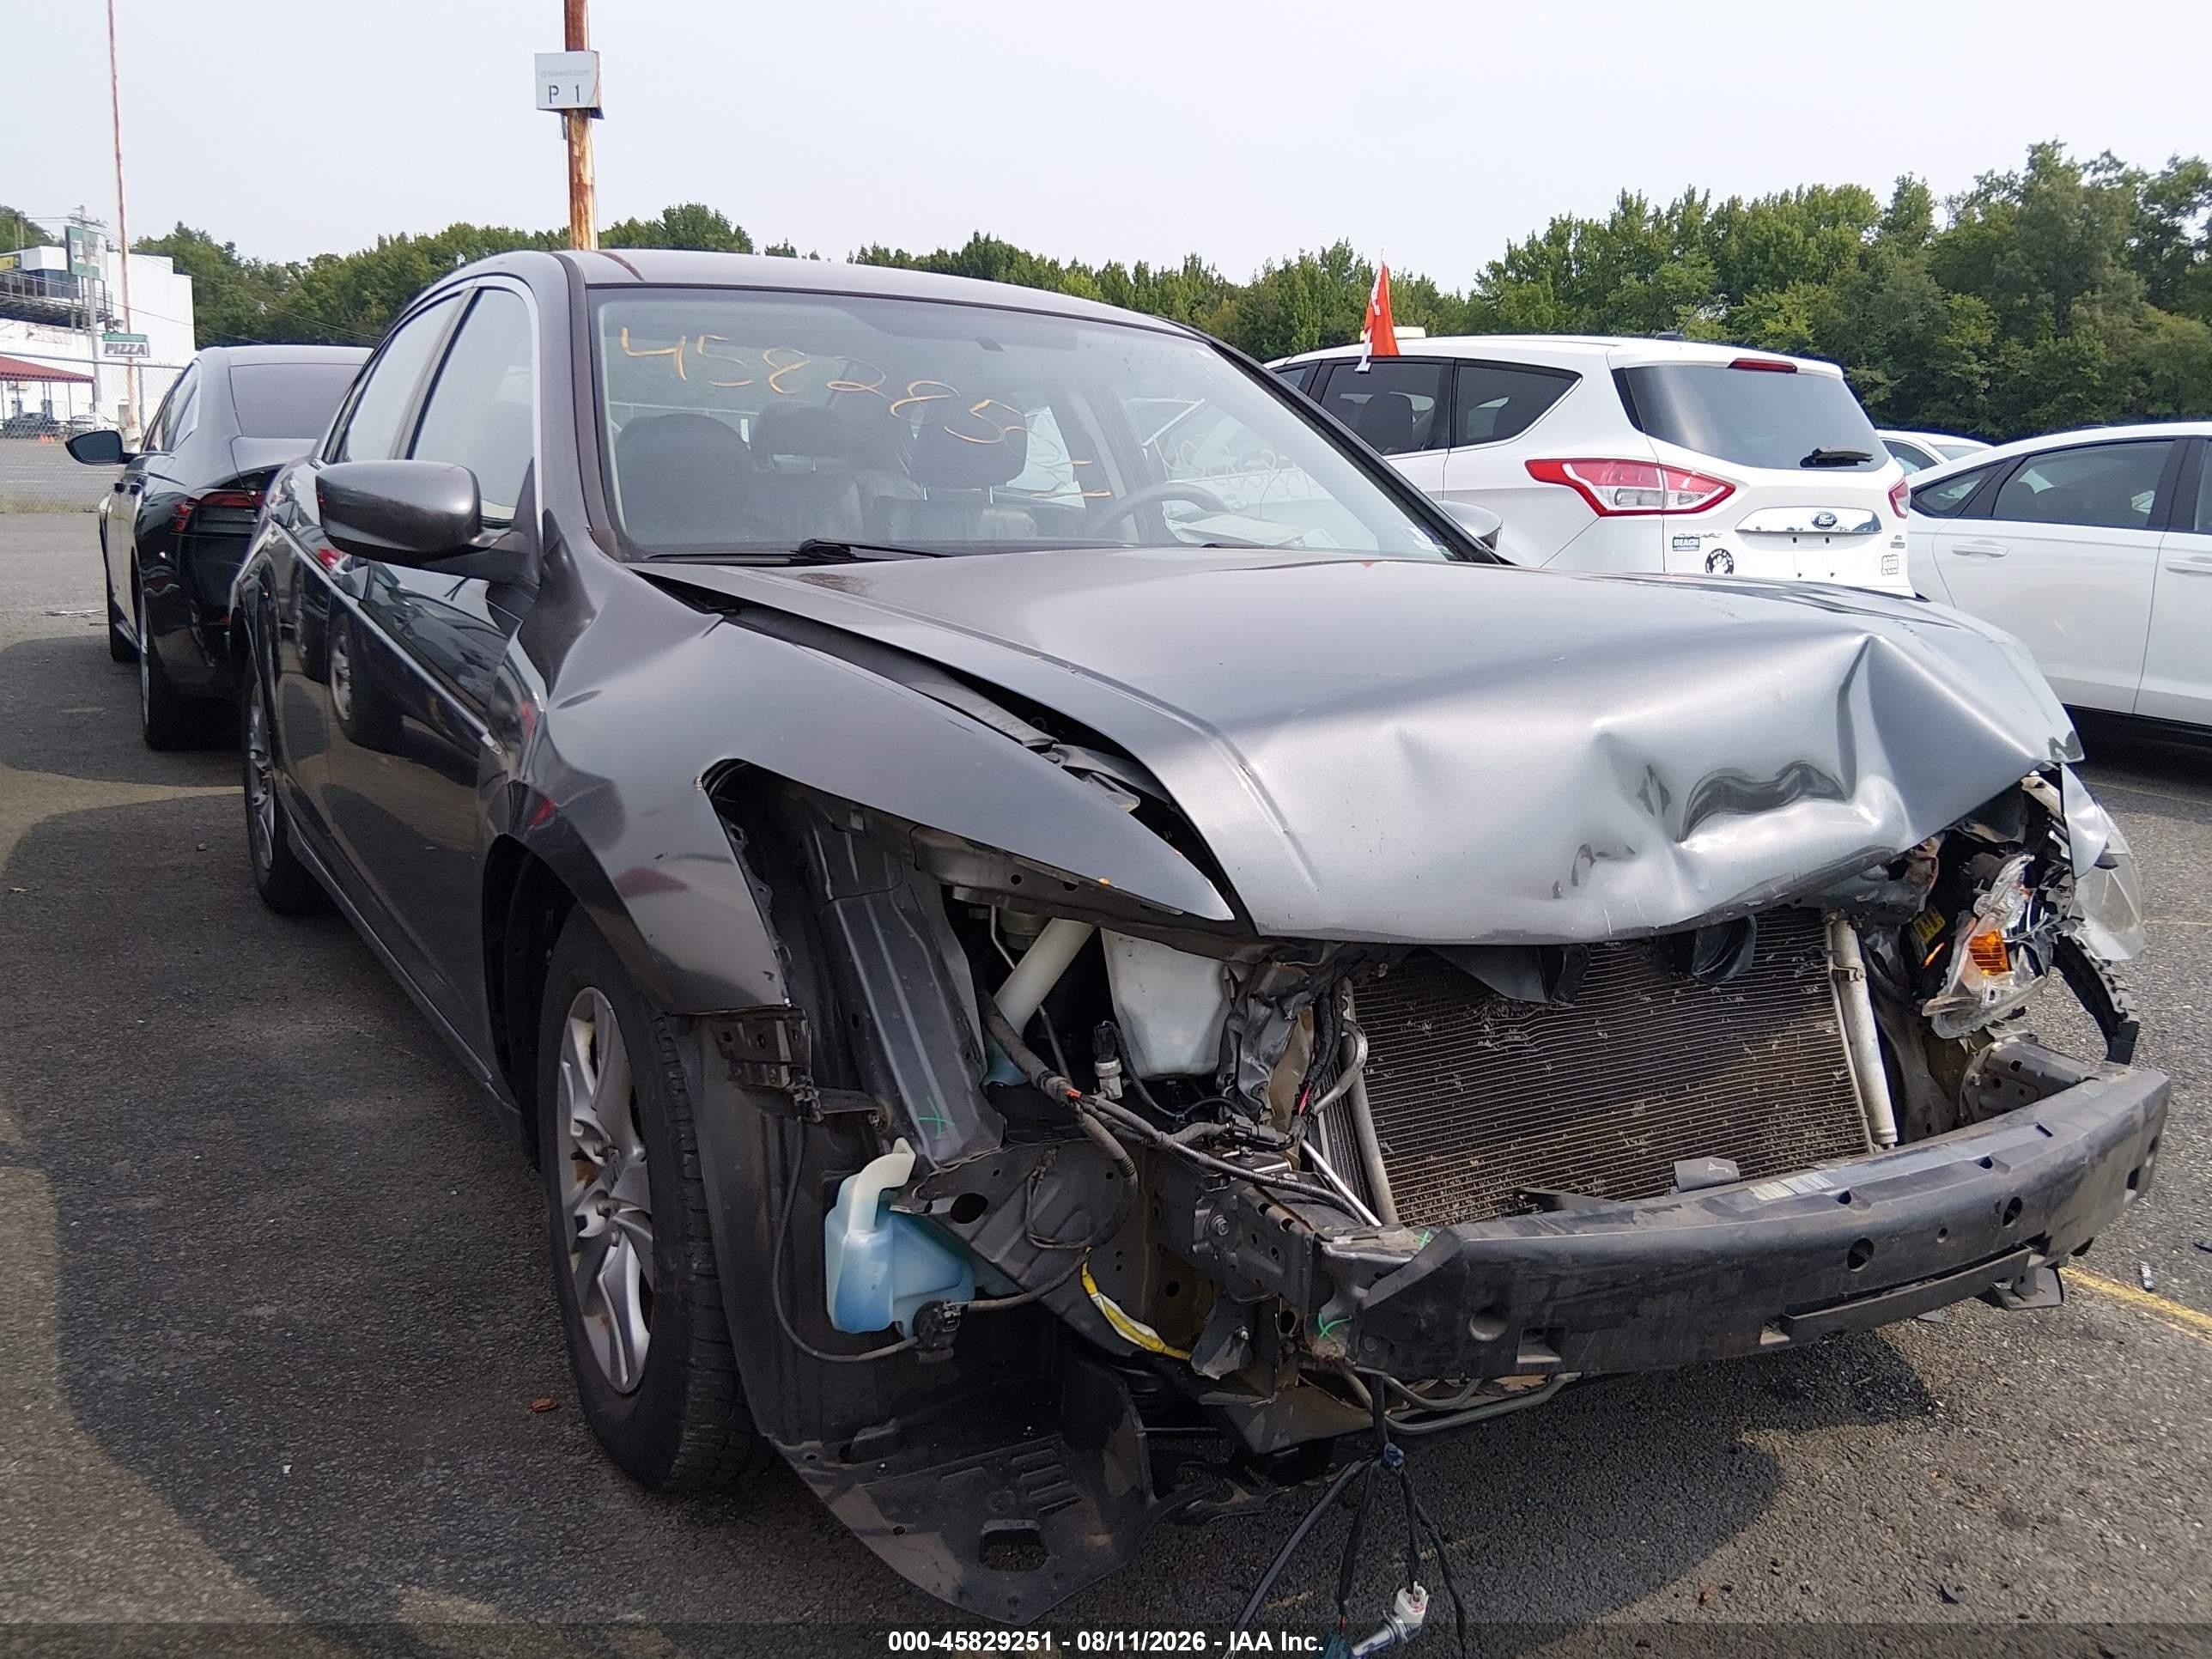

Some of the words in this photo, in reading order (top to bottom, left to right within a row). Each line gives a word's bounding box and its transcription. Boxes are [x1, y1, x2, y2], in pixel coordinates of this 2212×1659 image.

[549, 84, 560, 104] P
[104, 343, 147, 356] PIZZA
[1818, 514, 1834, 526] Ford
